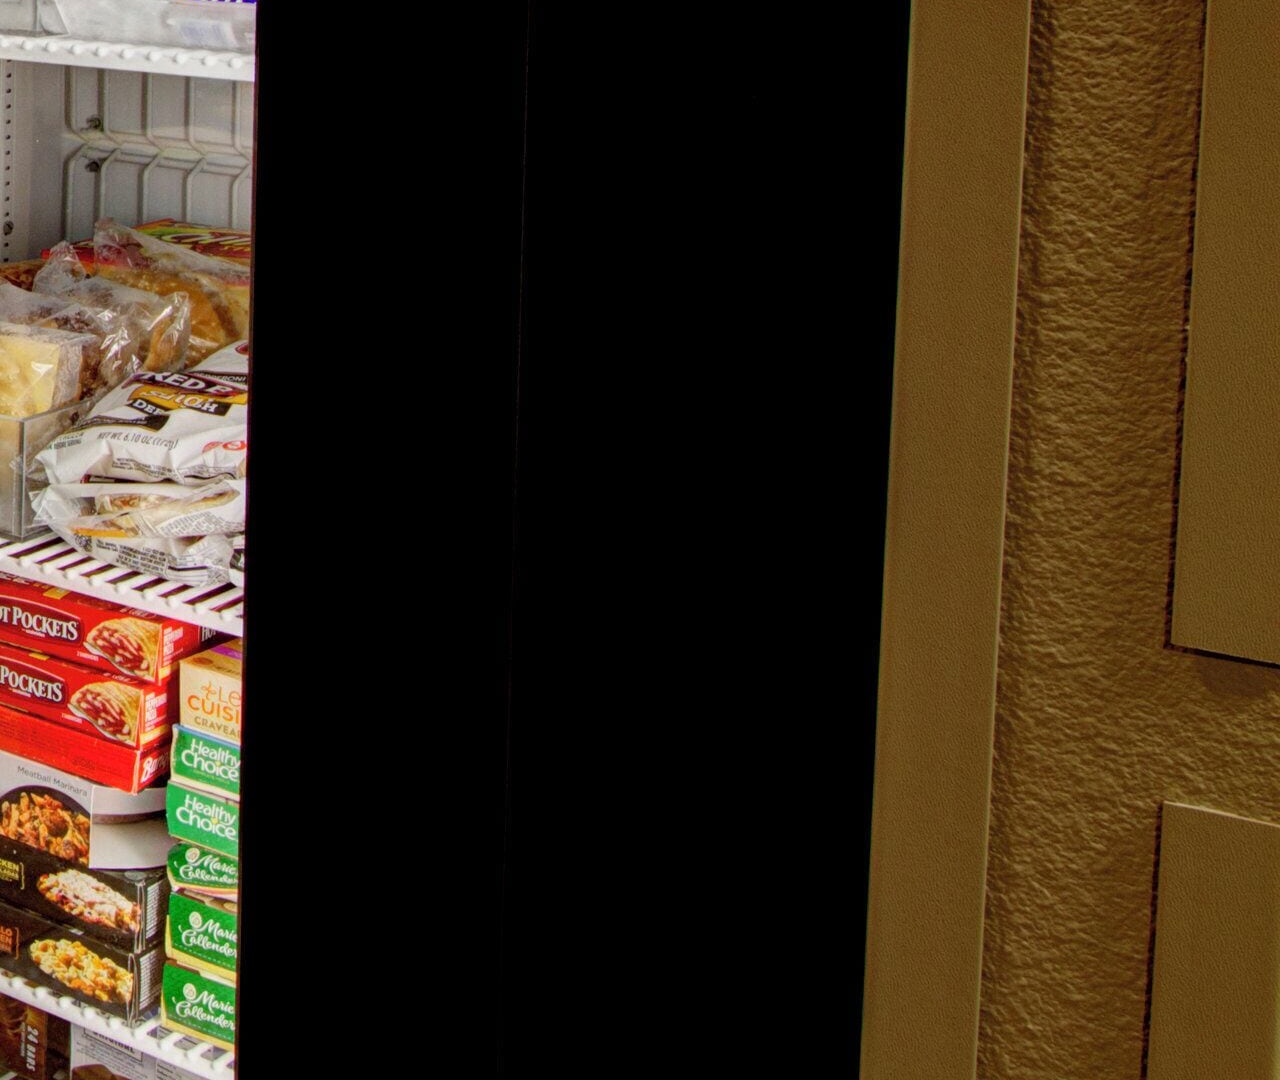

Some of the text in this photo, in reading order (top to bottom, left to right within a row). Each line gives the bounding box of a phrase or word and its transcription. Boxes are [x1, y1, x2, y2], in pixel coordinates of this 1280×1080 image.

[11, 606, 79, 641] POCKETS
[0, 666, 63, 703] POCKETS
[187, 695, 240, 725] CUISI
[181, 749, 240, 782] Choice
[190, 738, 240, 768] Healthy
[17, 765, 88, 797] Meatball Marinara
[176, 807, 237, 841] Choice
[184, 794, 236, 827] Healthy
[27, 1026, 39, 1043] 24
